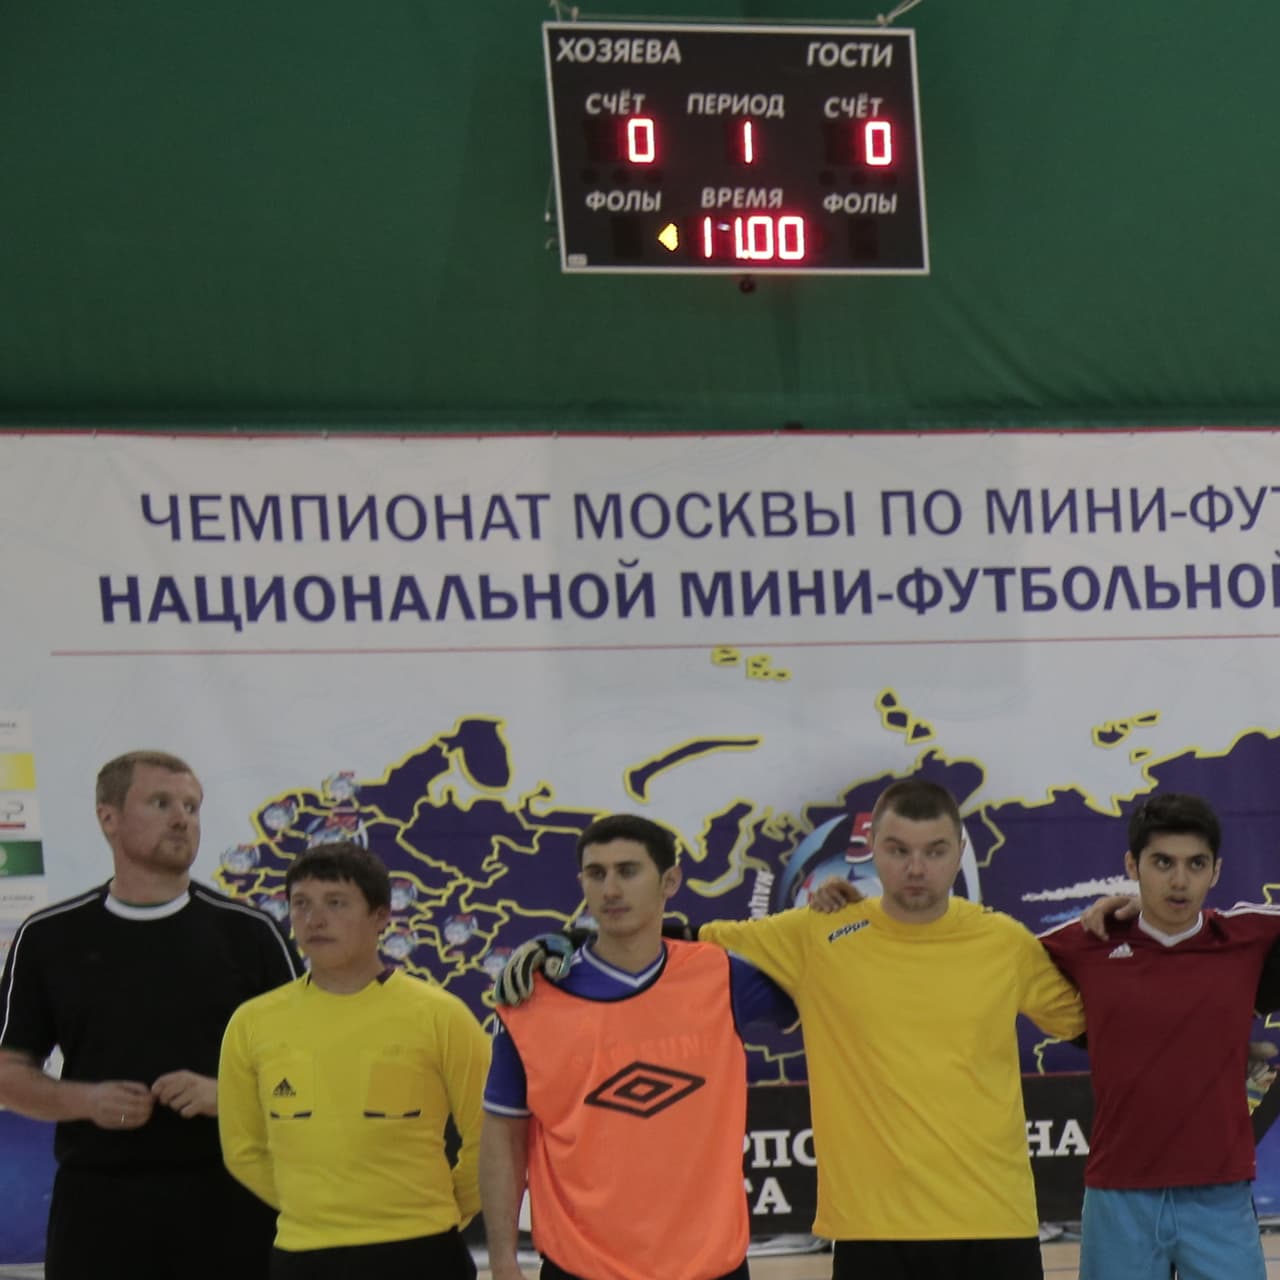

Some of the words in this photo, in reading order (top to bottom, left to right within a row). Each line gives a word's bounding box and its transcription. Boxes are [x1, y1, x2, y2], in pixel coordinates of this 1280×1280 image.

[556, 38, 682, 65] ХОЗЯЕВА
[807, 42, 893, 67] ГОСТИ
[585, 90, 645, 115] СЧЁТ
[687, 94, 785, 119] ПЕРИОД
[824, 93, 883, 118] СЧЁТ
[627, 118, 654, 162] 0
[743, 121, 753, 163] 1
[865, 121, 892, 165] 0
[585, 191, 661, 211] ФОЛЫ
[701, 188, 783, 208] ВРЕМЯ
[823, 193, 897, 213] ФОЛЫ
[141, 492, 550, 543] ЧЕМПИОНАТ
[574, 490, 856, 539] МОСКВЫ
[881, 488, 962, 537] ПО
[99, 559, 657, 630] НАЦИОНАЛЬНОЙ
